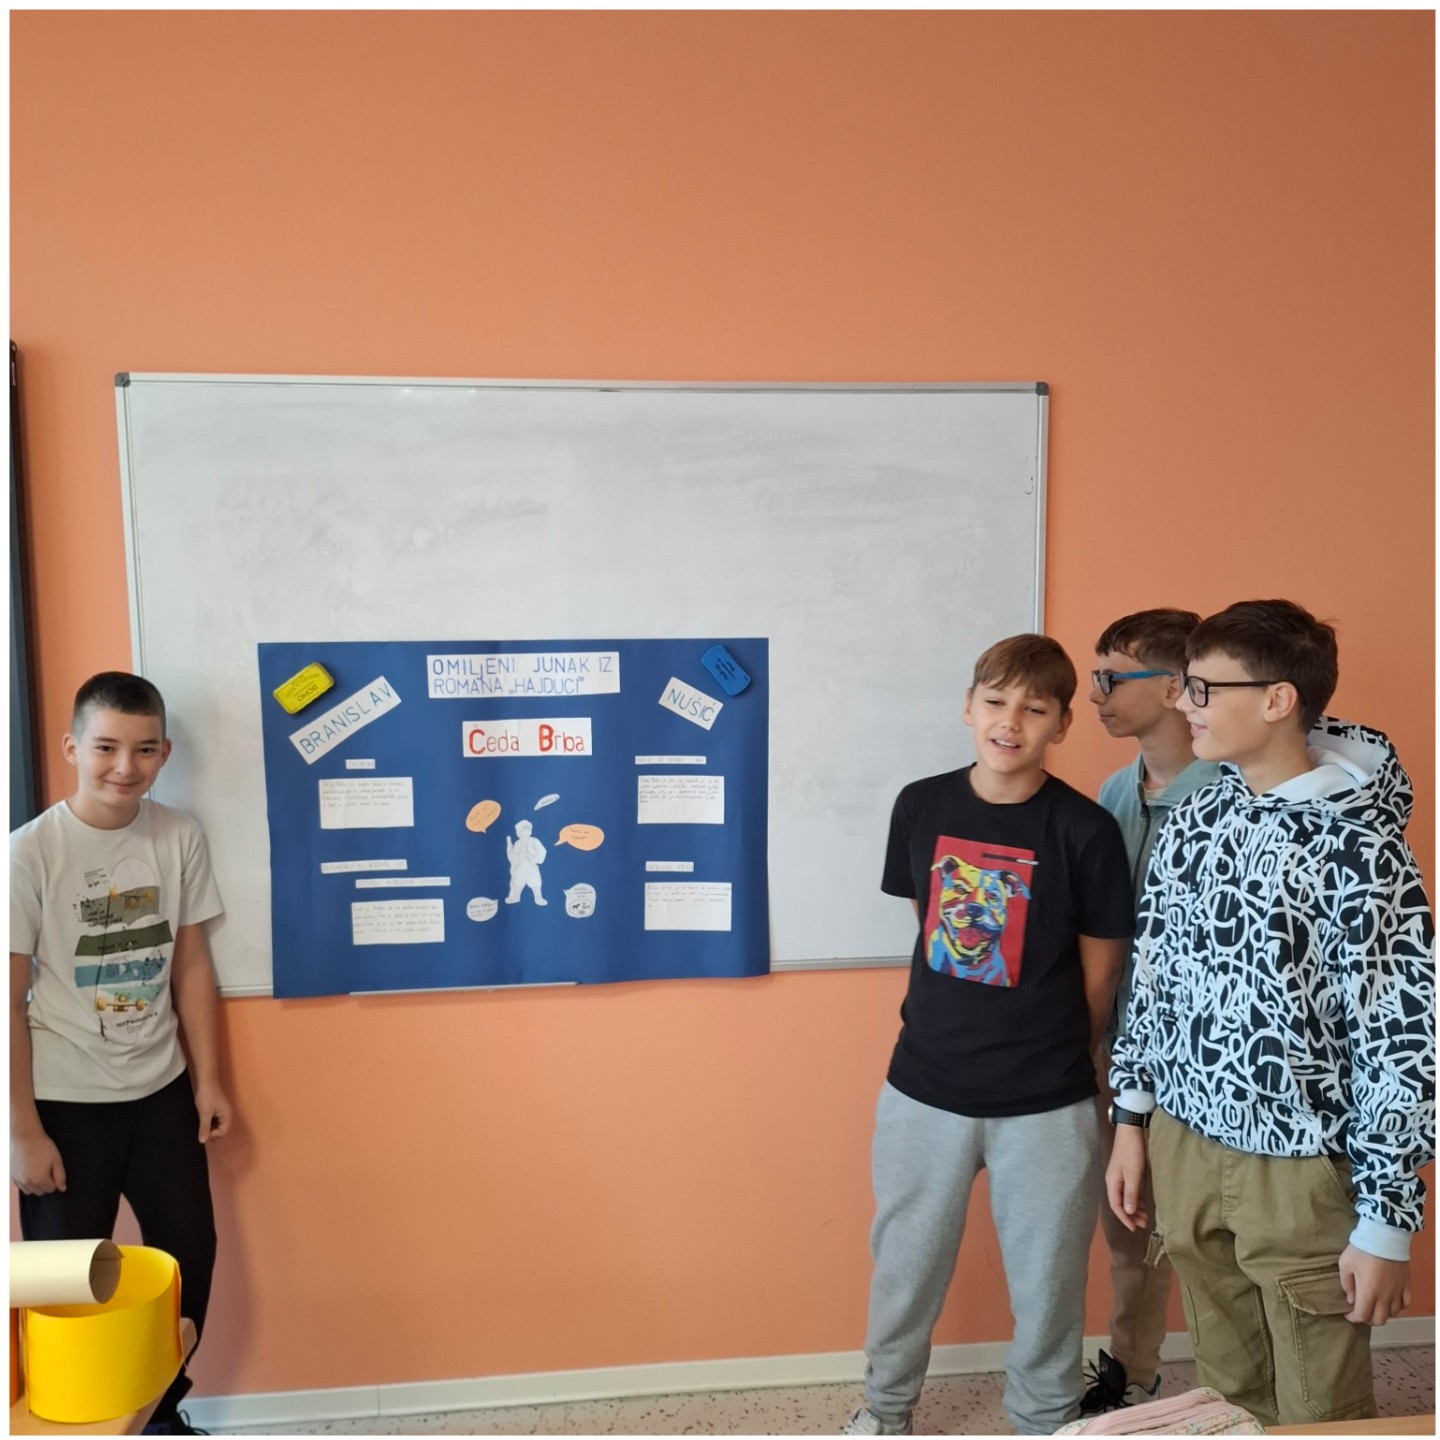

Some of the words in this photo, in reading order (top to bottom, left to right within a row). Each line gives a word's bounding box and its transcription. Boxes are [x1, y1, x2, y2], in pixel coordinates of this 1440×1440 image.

[533, 656, 590, 673] JUNAK
[599, 657, 612, 672] IZ
[434, 678, 503, 695] ROMANA
[300, 683, 391, 754] BRANISLAV
[667, 688, 716, 721] NUŠIĆ
[469, 723, 519, 754] Čeda
[539, 724, 585, 753] Brba
